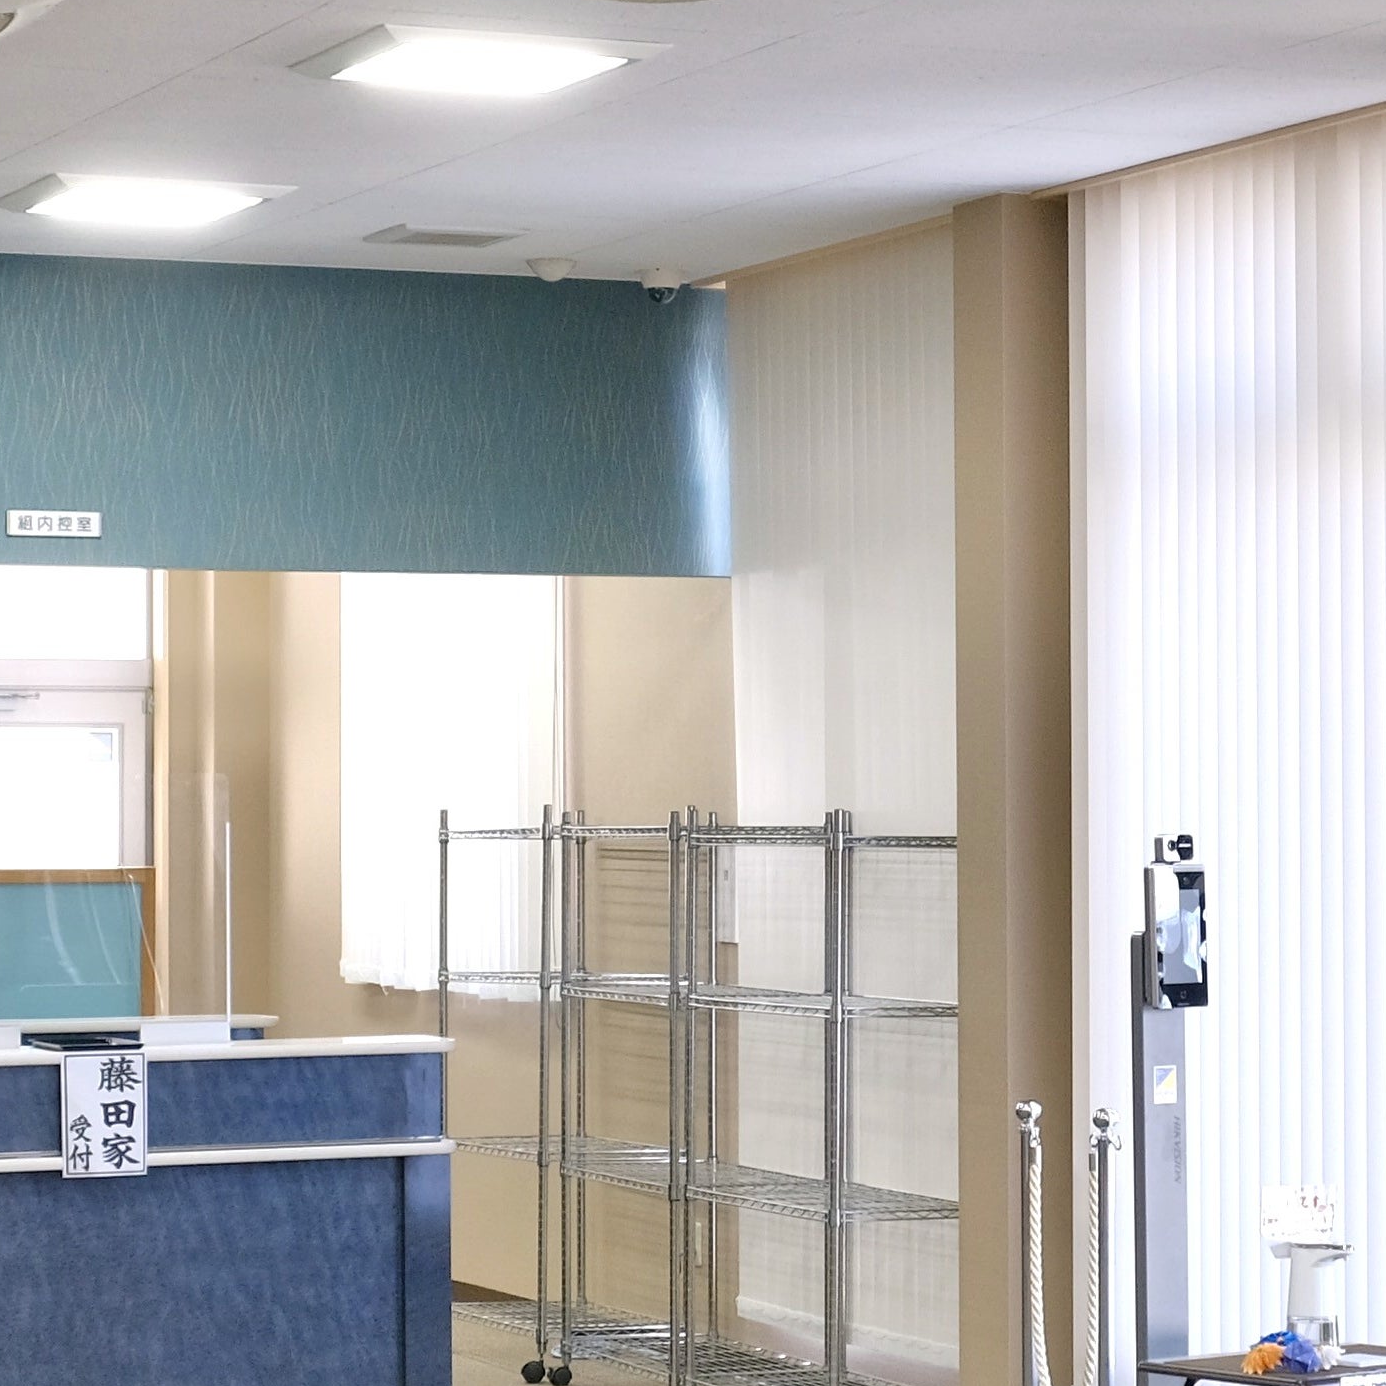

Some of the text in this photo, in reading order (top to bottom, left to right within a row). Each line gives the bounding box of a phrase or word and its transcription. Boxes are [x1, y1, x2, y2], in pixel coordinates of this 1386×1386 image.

[69, 1114, 94, 1171] 受付
[98, 1056, 142, 1170] 藤田家
